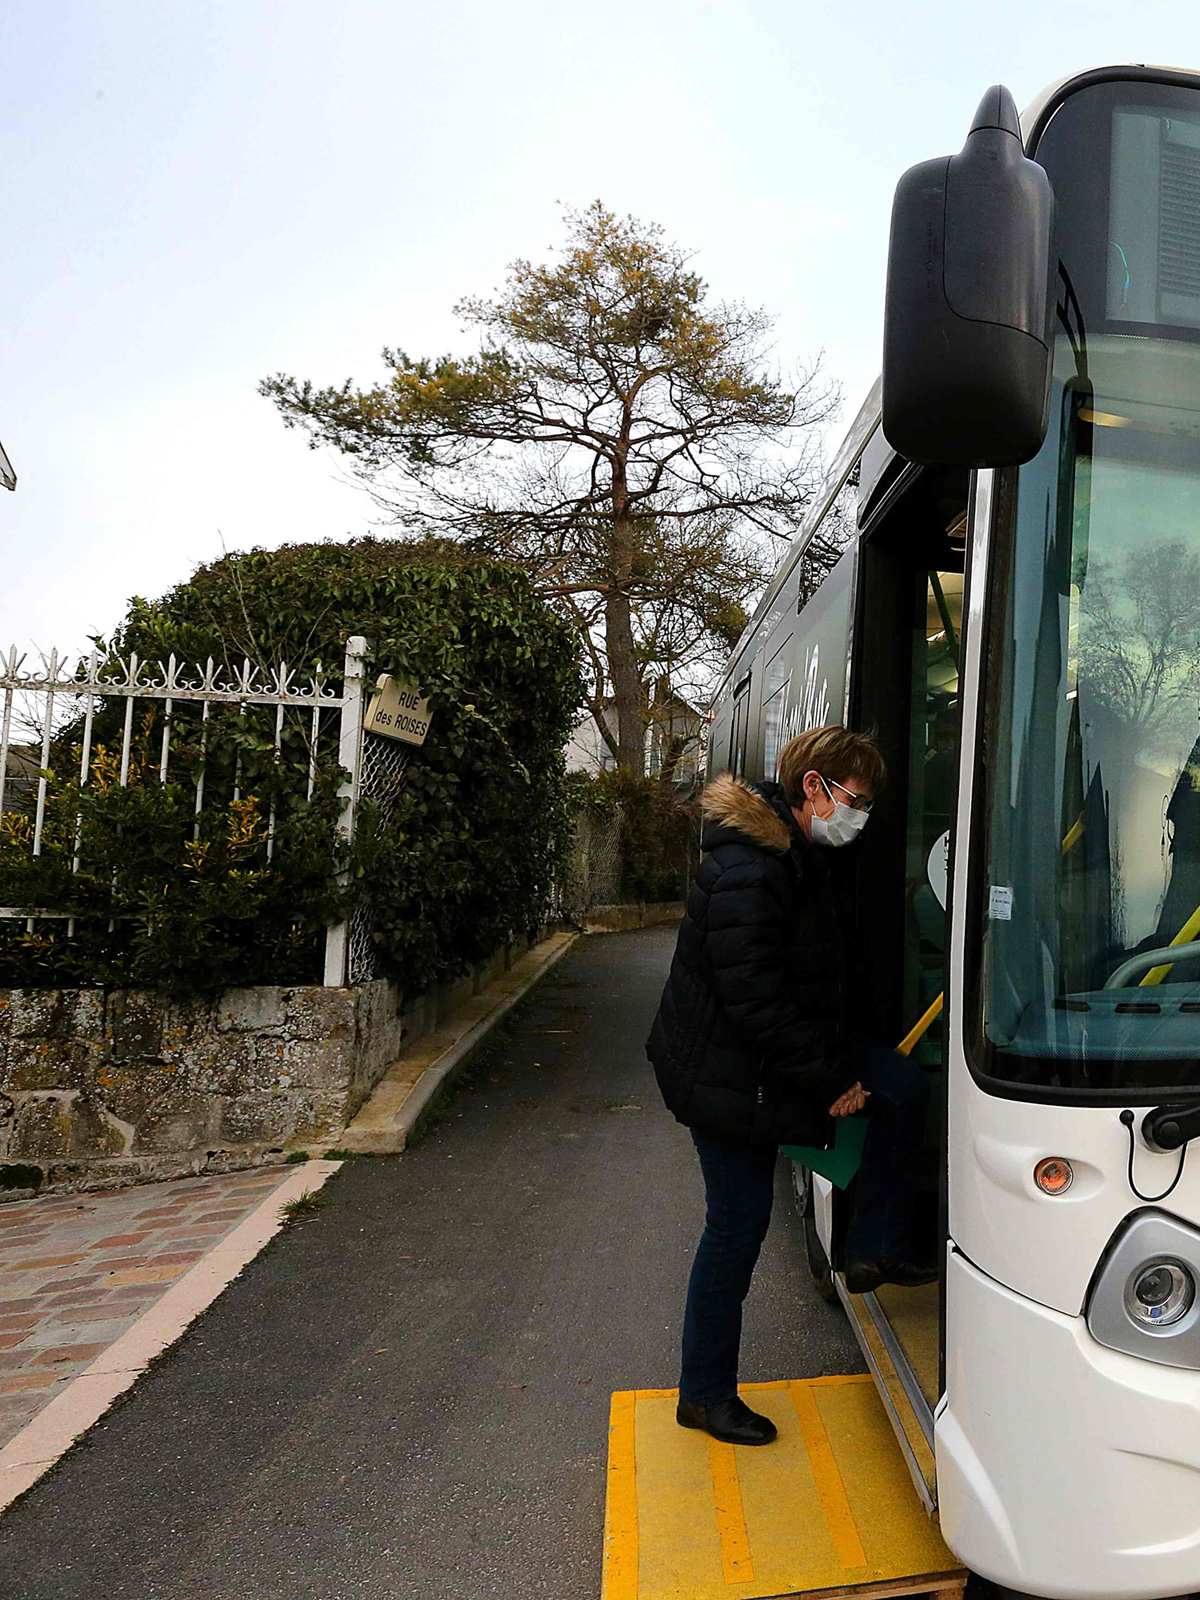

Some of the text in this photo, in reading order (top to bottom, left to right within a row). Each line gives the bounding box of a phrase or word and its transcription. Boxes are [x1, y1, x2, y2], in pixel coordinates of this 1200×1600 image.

[398, 692, 420, 711] RUE
[376, 709, 427, 736] des ROISES
